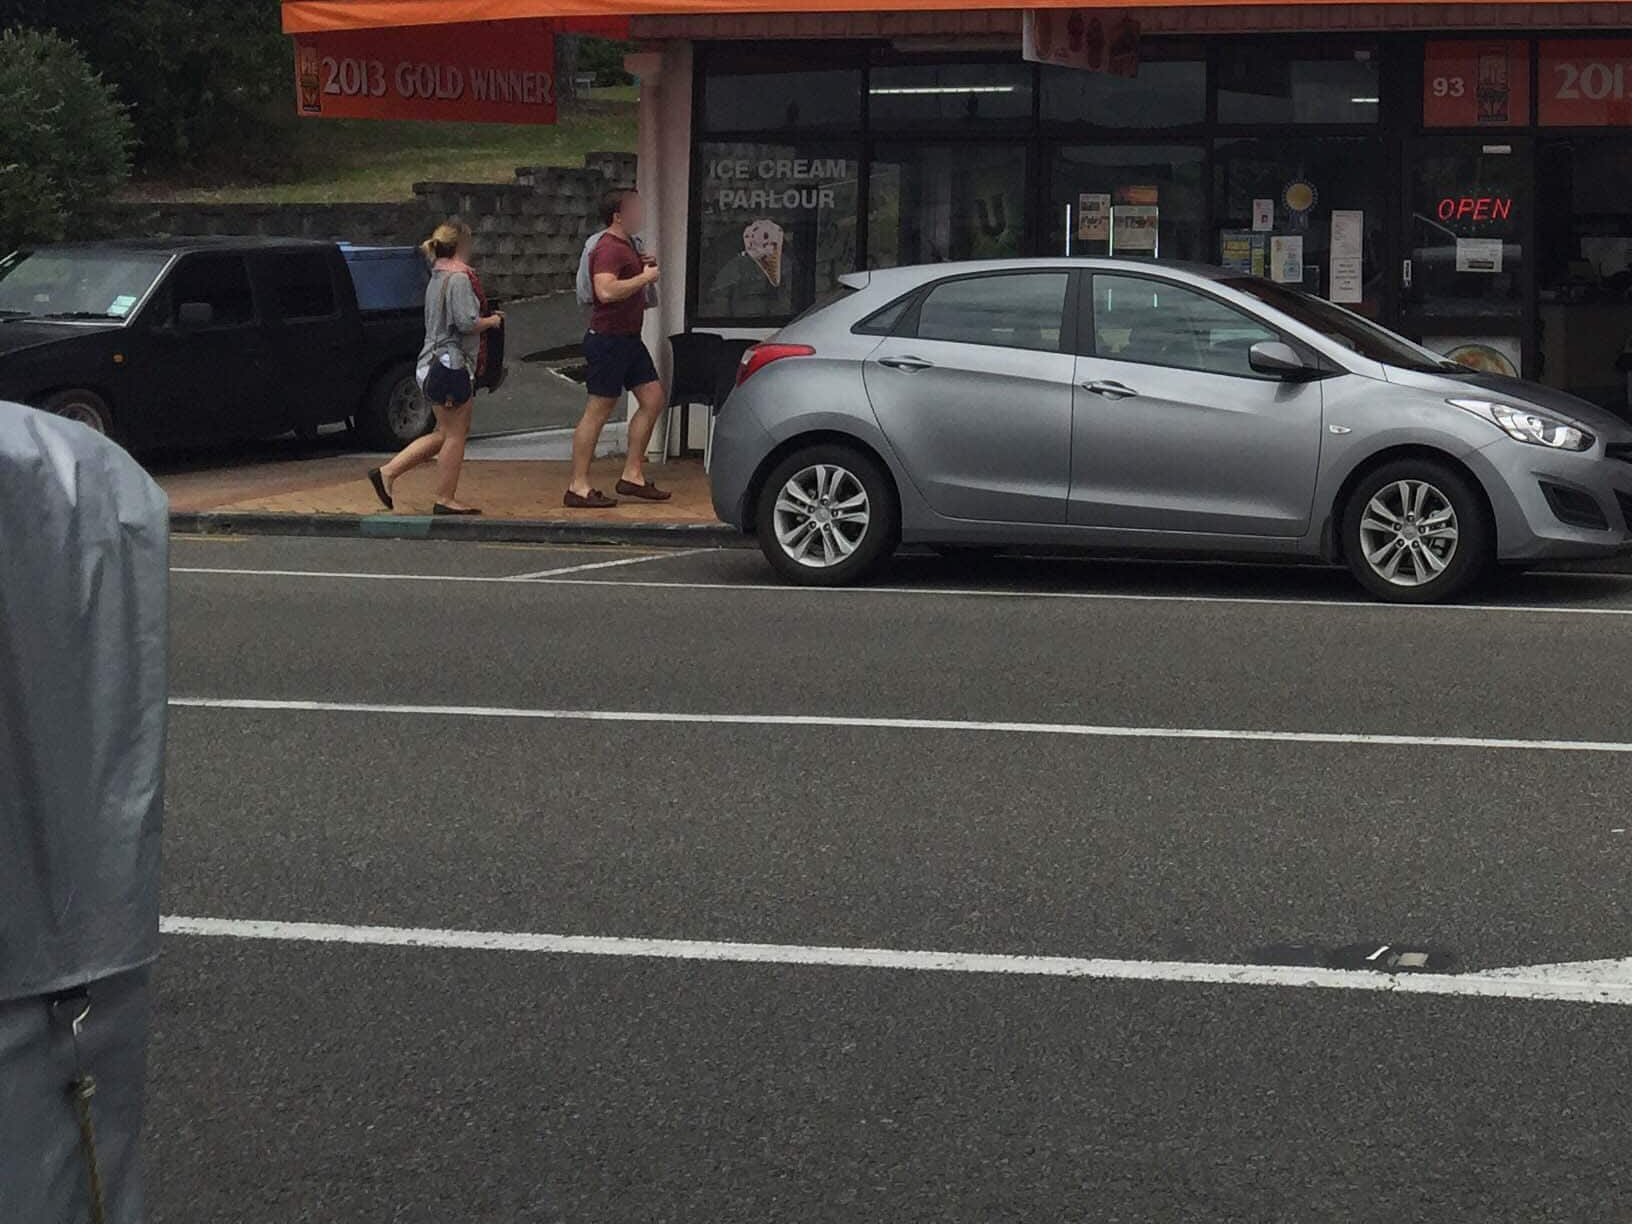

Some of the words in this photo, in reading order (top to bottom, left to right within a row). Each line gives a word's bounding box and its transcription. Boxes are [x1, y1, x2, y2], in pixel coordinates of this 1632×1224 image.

[321, 55, 386, 97] 2013
[394, 62, 464, 101] GOLD
[468, 67, 553, 105] WINNER
[1432, 76, 1465, 97] 93
[709, 159, 751, 179] ICE
[758, 159, 847, 179] CREAM
[719, 189, 836, 209] PARLOUR
[1437, 197, 1513, 222] OPEN
